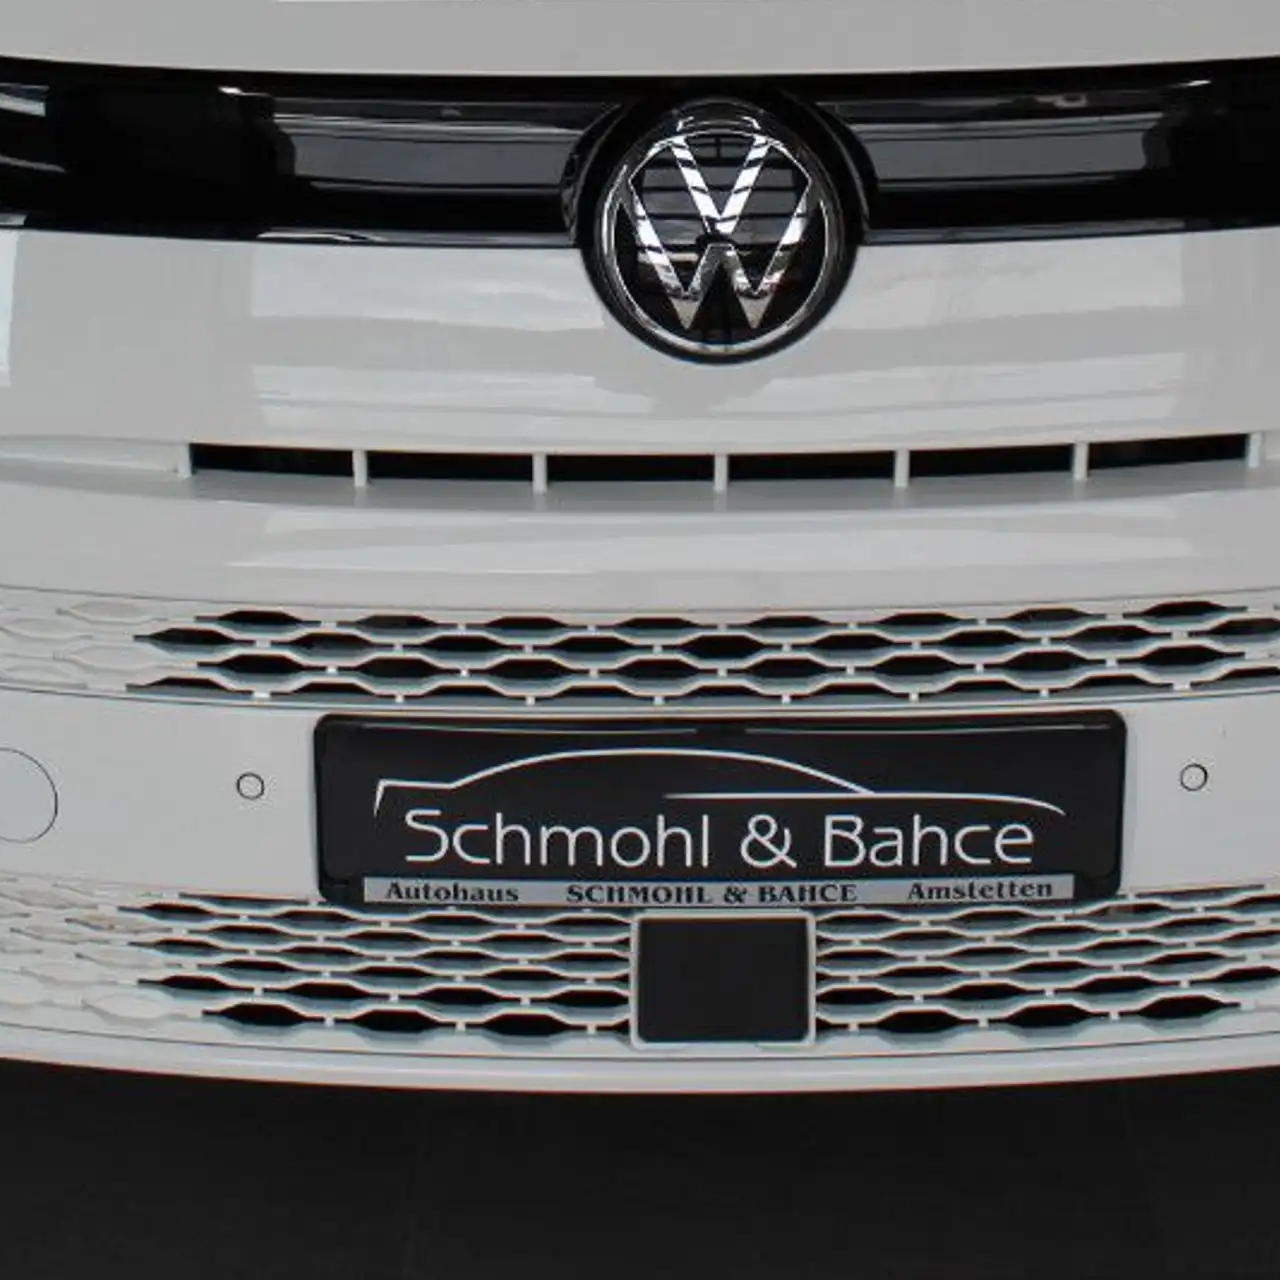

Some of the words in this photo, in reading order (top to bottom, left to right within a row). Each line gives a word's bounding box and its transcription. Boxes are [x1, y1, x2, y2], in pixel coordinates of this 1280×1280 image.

[600, 122, 832, 352] VW
[404, 808, 709, 868] Schmohl
[739, 813, 798, 869] &
[823, 813, 1035, 867] Bahce
[385, 881, 520, 903] Autohaus
[565, 884, 715, 905] SCHMOHL
[723, 886, 749, 904] &
[757, 883, 858, 904] BAHCE
[907, 880, 1054, 901] Amstetten
